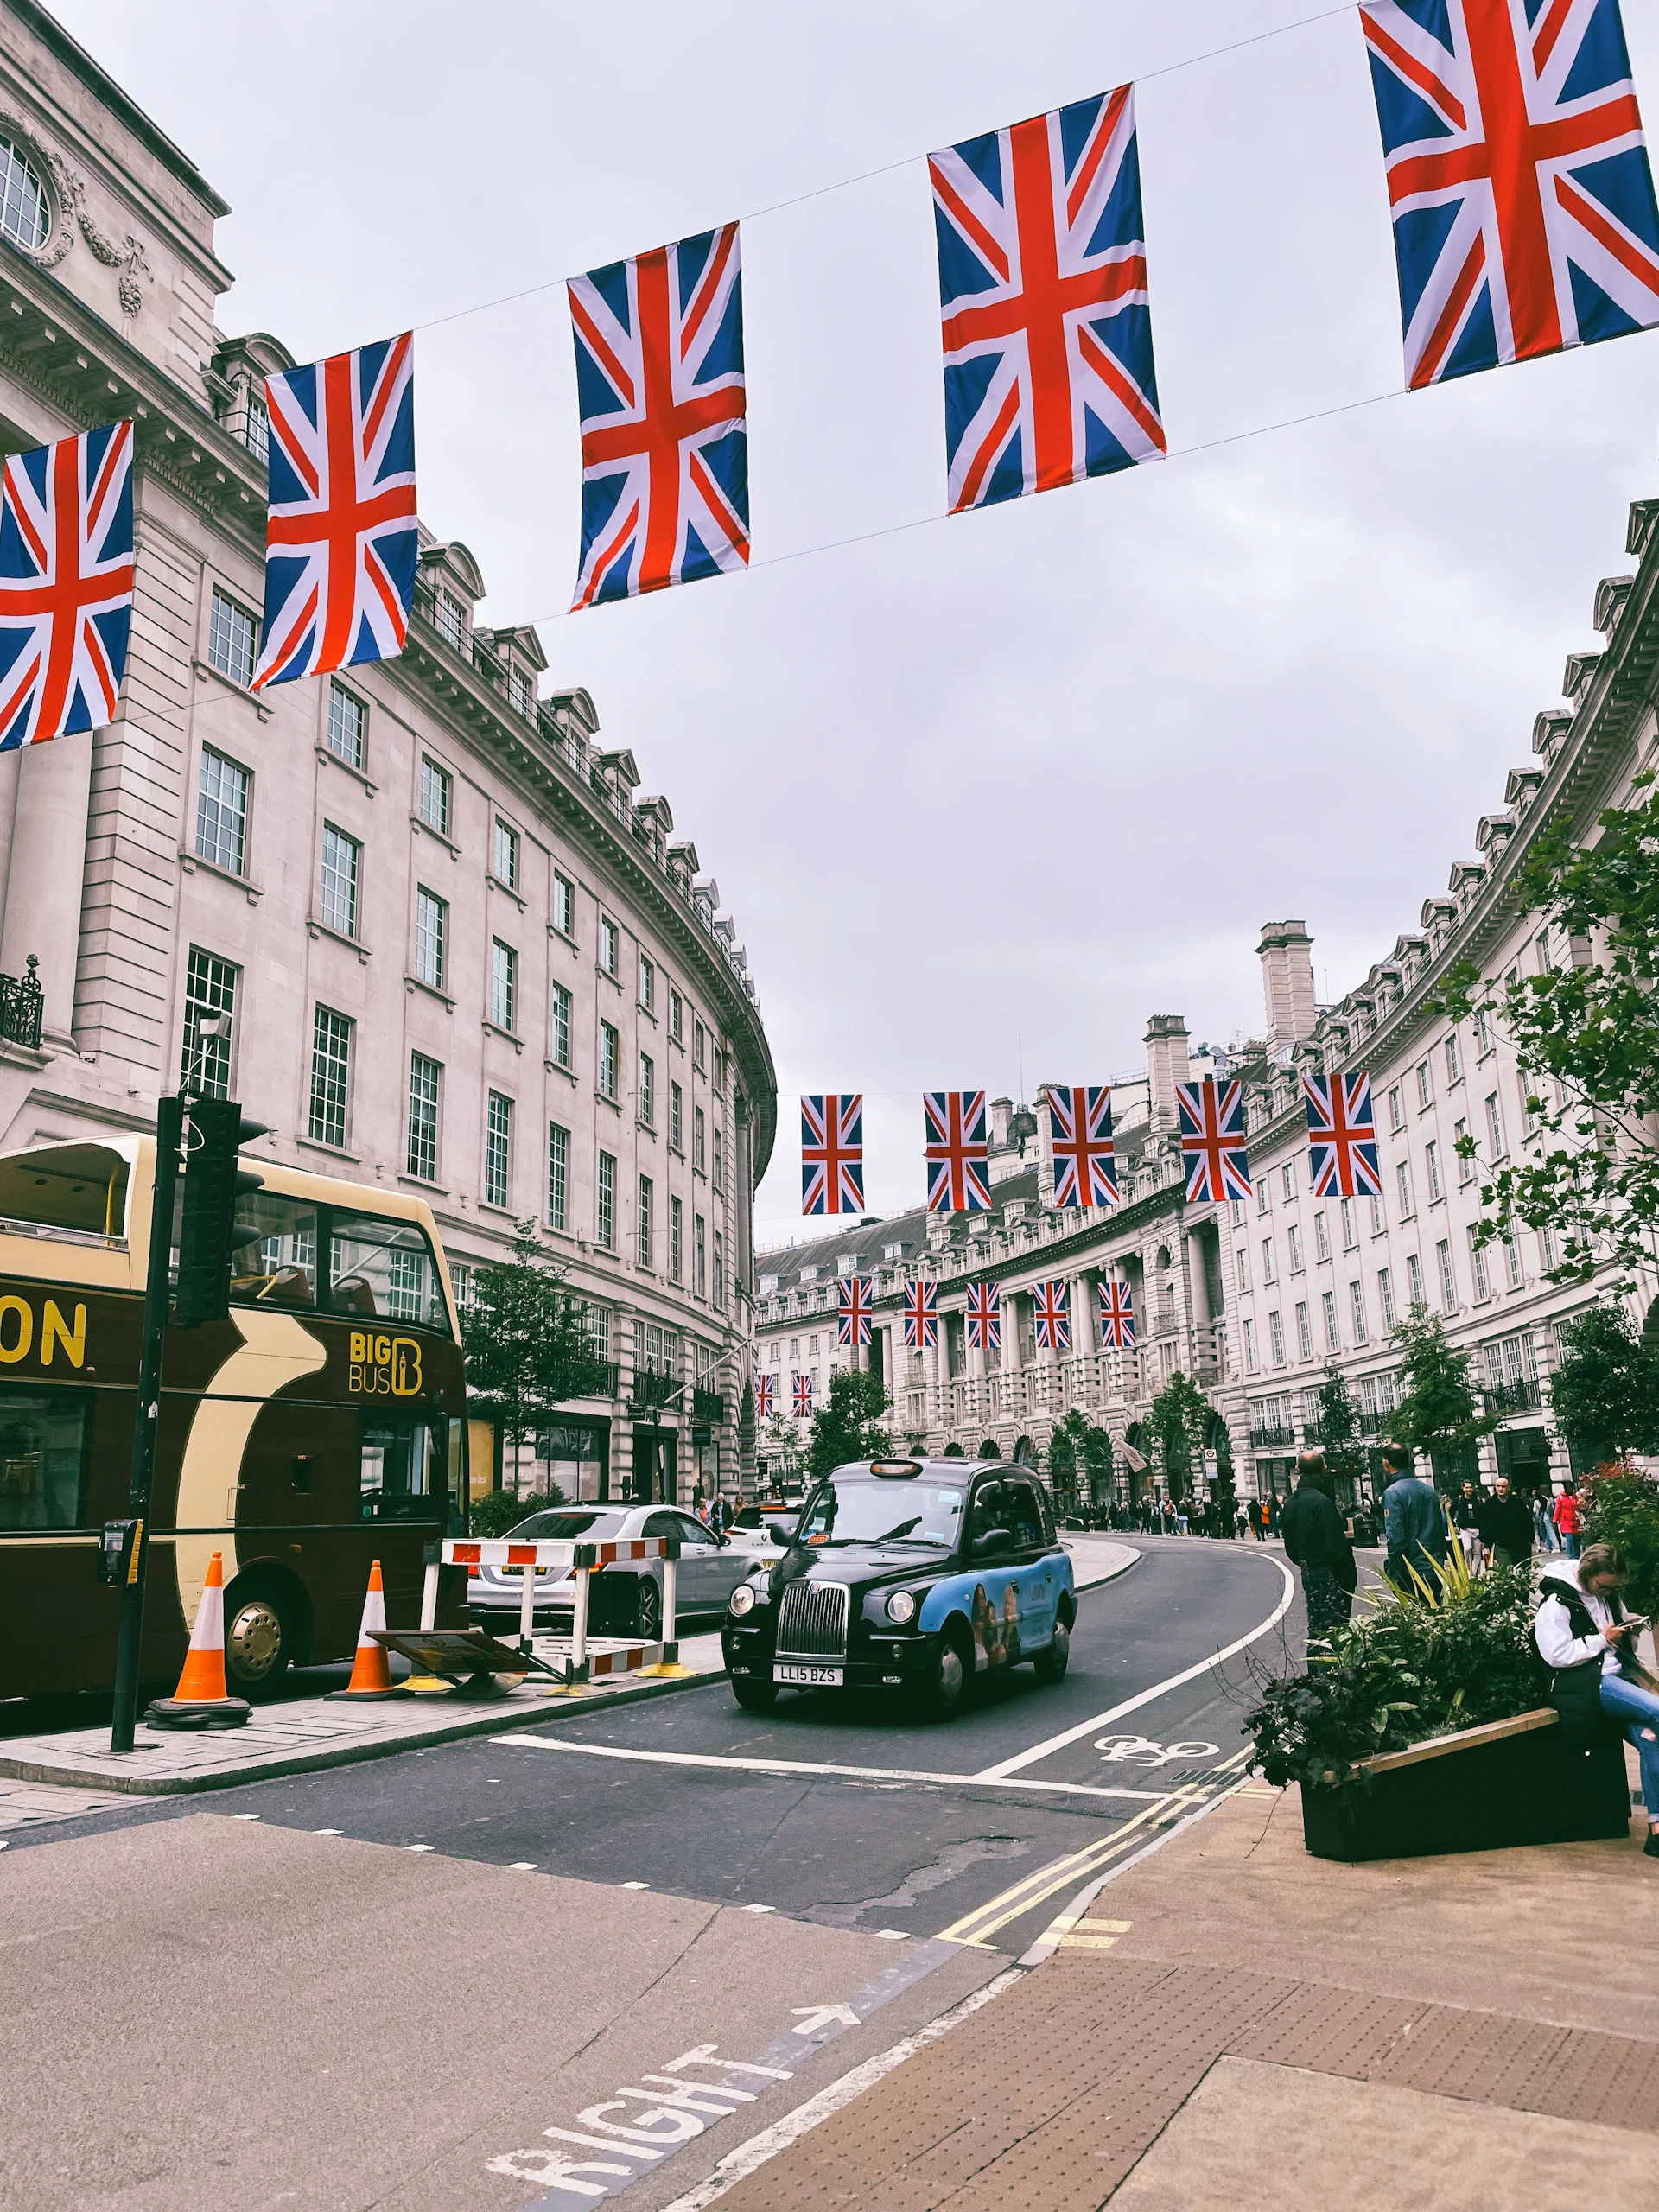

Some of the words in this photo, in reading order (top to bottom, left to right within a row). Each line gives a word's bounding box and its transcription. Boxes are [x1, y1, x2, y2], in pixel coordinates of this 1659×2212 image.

[0, 1295, 86, 1368] ON
[350, 1332, 391, 1365] BIG
[348, 1364, 391, 1395] BUS
[780, 1665, 807, 1681] LL15
[810, 1668, 835, 1682] BZS
[484, 2044, 794, 2196] RIGHT
